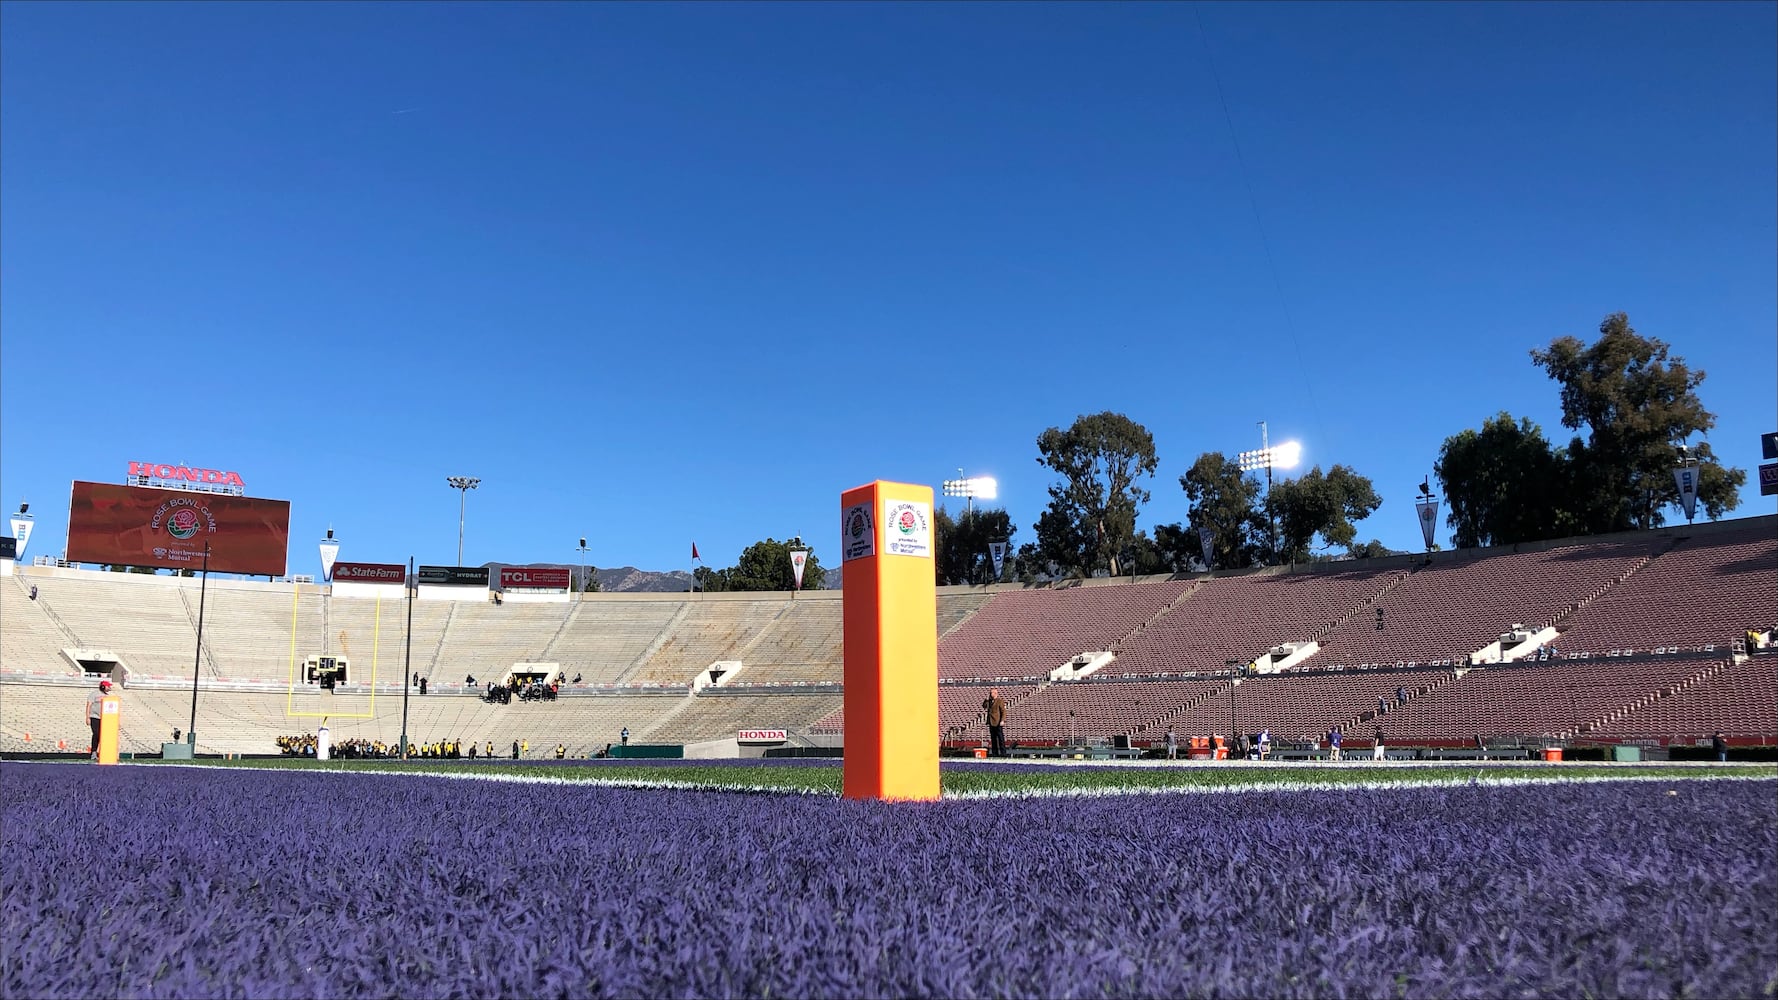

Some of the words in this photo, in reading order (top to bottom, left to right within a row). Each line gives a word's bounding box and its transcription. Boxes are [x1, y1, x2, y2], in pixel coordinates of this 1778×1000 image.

[128, 461, 245, 486] HONDA
[898, 504, 915, 512] BOWL
[151, 504, 170, 529] ROSE
[169, 498, 201, 509] BOWL
[200, 506, 217, 533] GAME
[502, 572, 532, 582] TCL
[740, 731, 785, 739] HONDA
